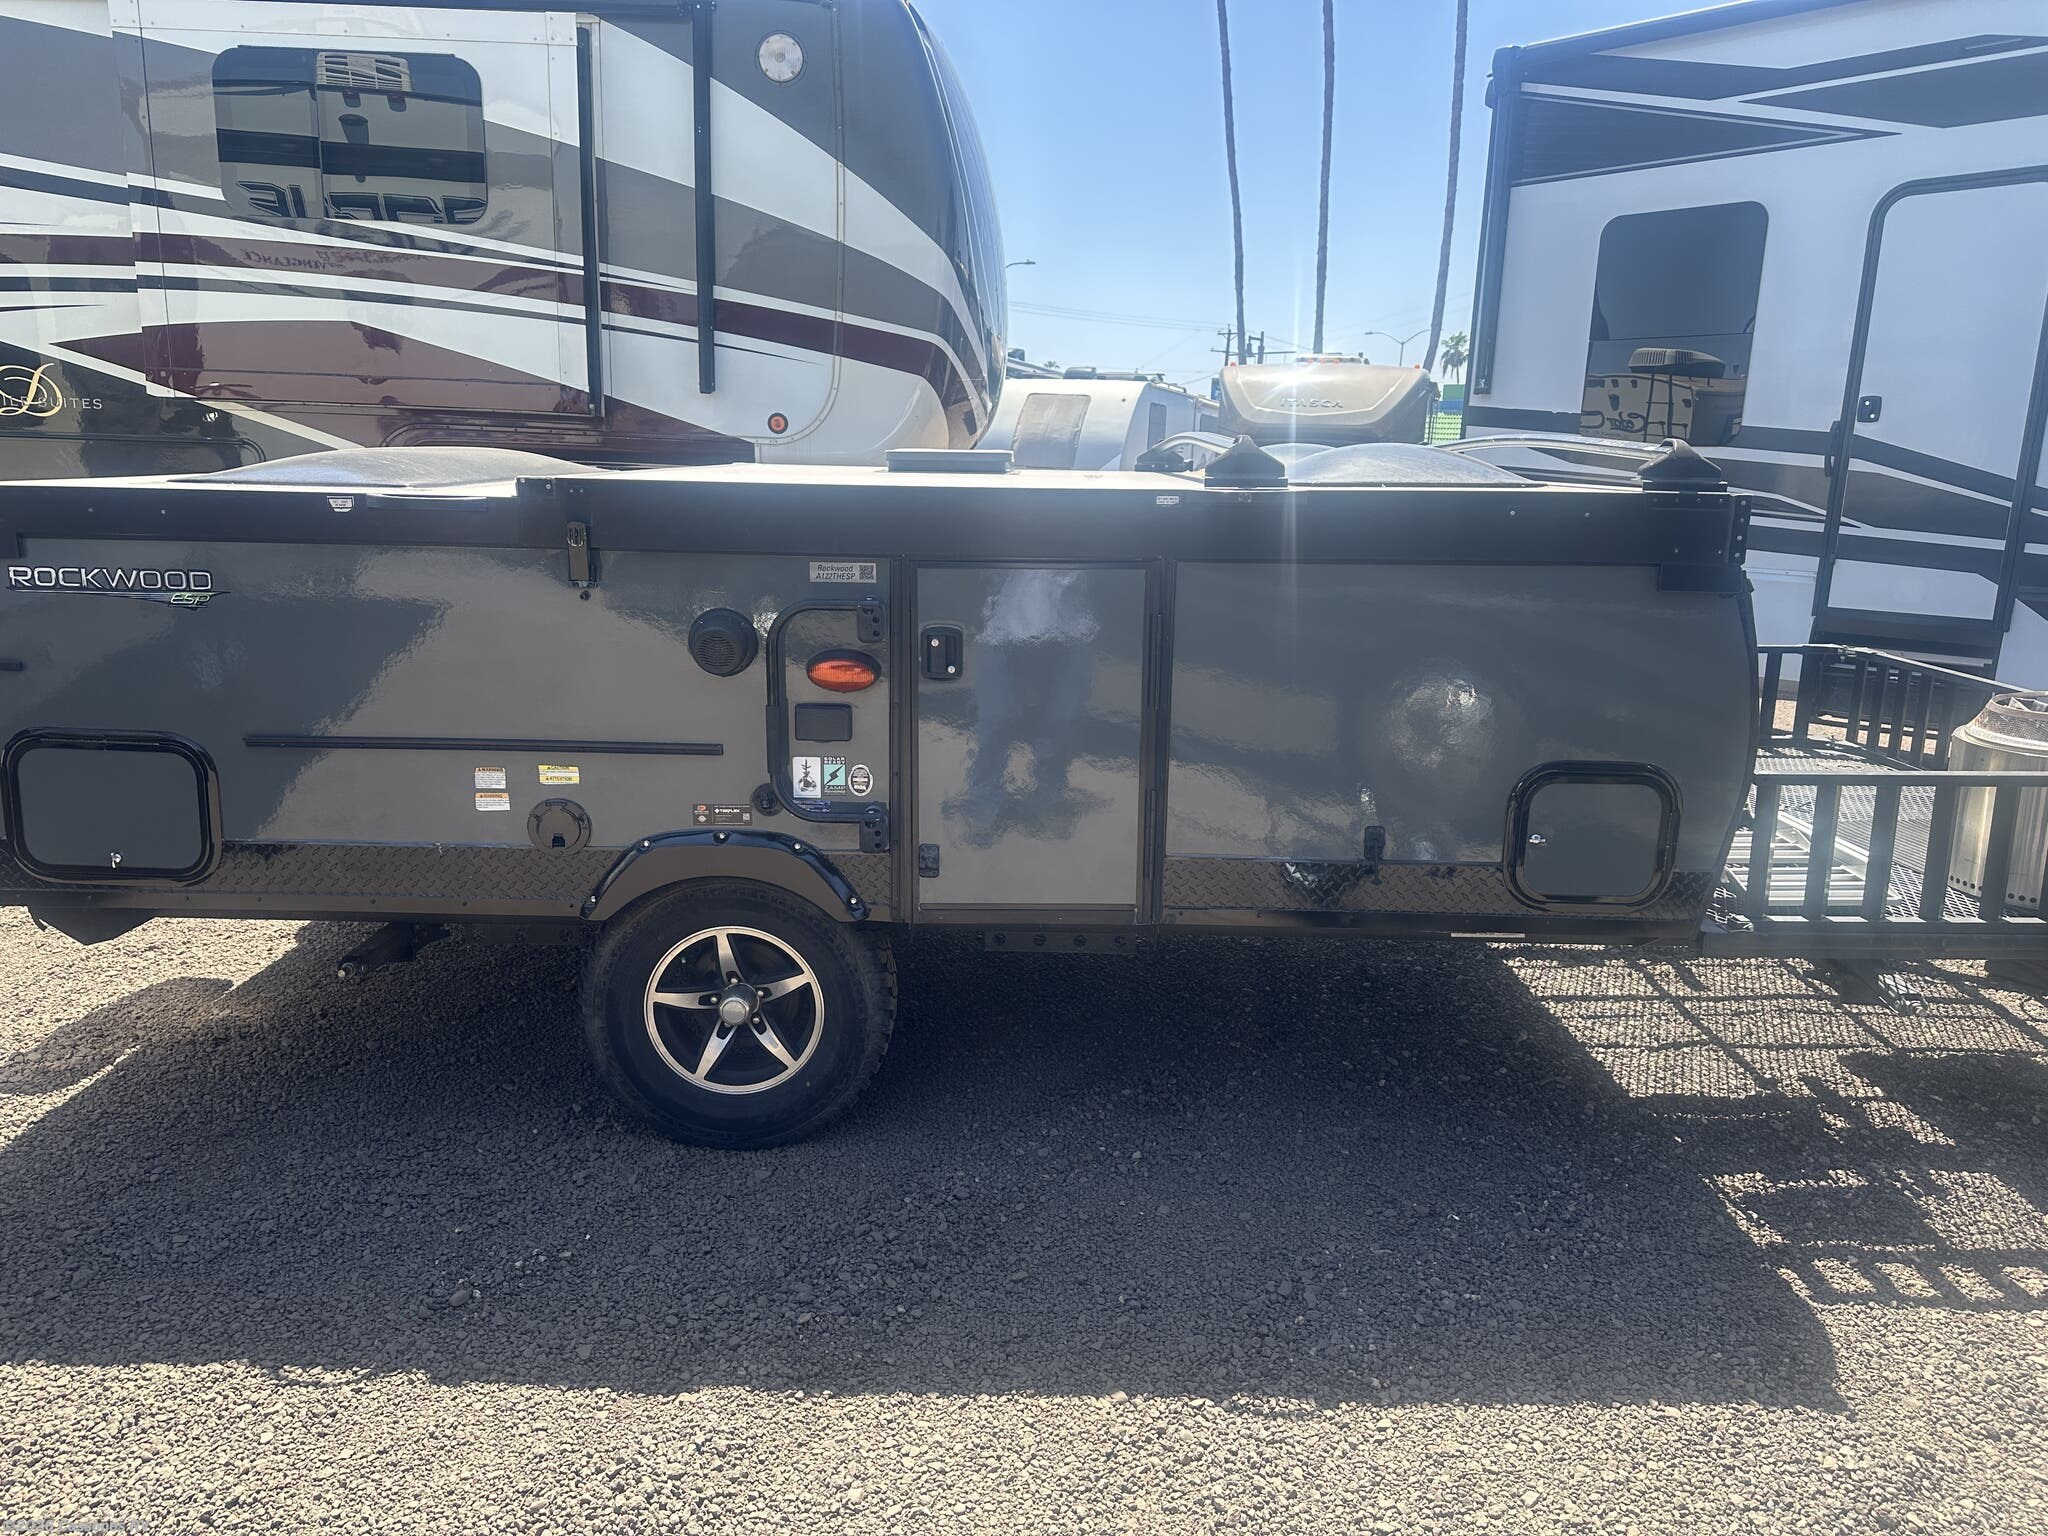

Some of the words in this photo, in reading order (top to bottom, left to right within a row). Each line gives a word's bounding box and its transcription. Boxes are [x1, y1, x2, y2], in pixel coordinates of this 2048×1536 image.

[38, 396, 103, 409] SUITES
[1280, 398, 1345, 409] ITASCA
[817, 564, 854, 572] Rockwood
[8, 566, 212, 590] ROCKWOOD
[815, 572, 856, 580] A122THESP
[169, 593, 210, 605] ESP
